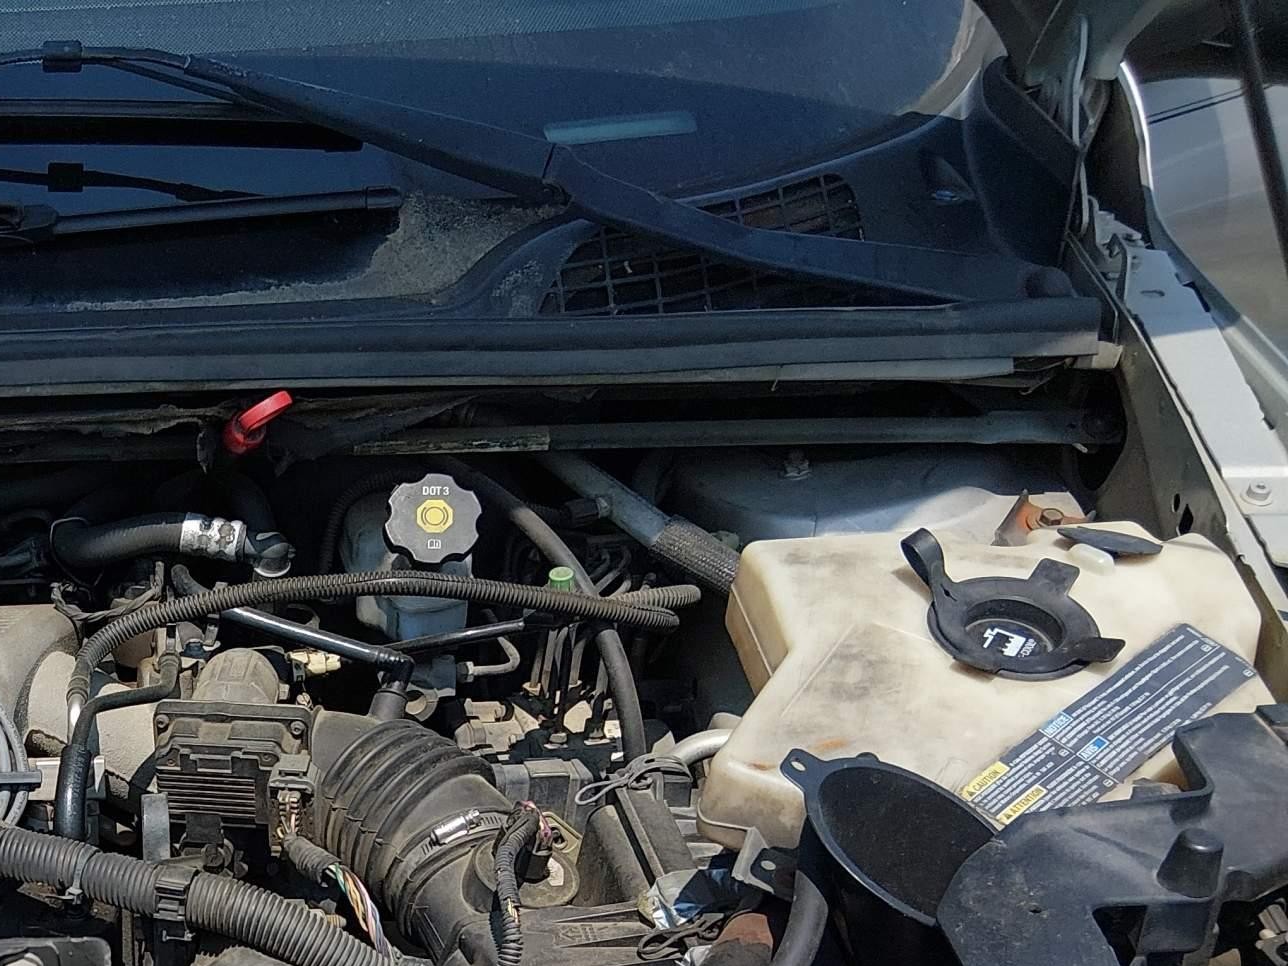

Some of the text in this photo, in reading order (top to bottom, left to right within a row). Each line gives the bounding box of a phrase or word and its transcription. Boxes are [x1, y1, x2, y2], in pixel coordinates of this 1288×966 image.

[422, 486, 449, 495] DOT 3
[1046, 715, 1069, 737] NOTICE
[972, 768, 1000, 793] CAUTION
[1010, 787, 1044, 817] ATTENTION
